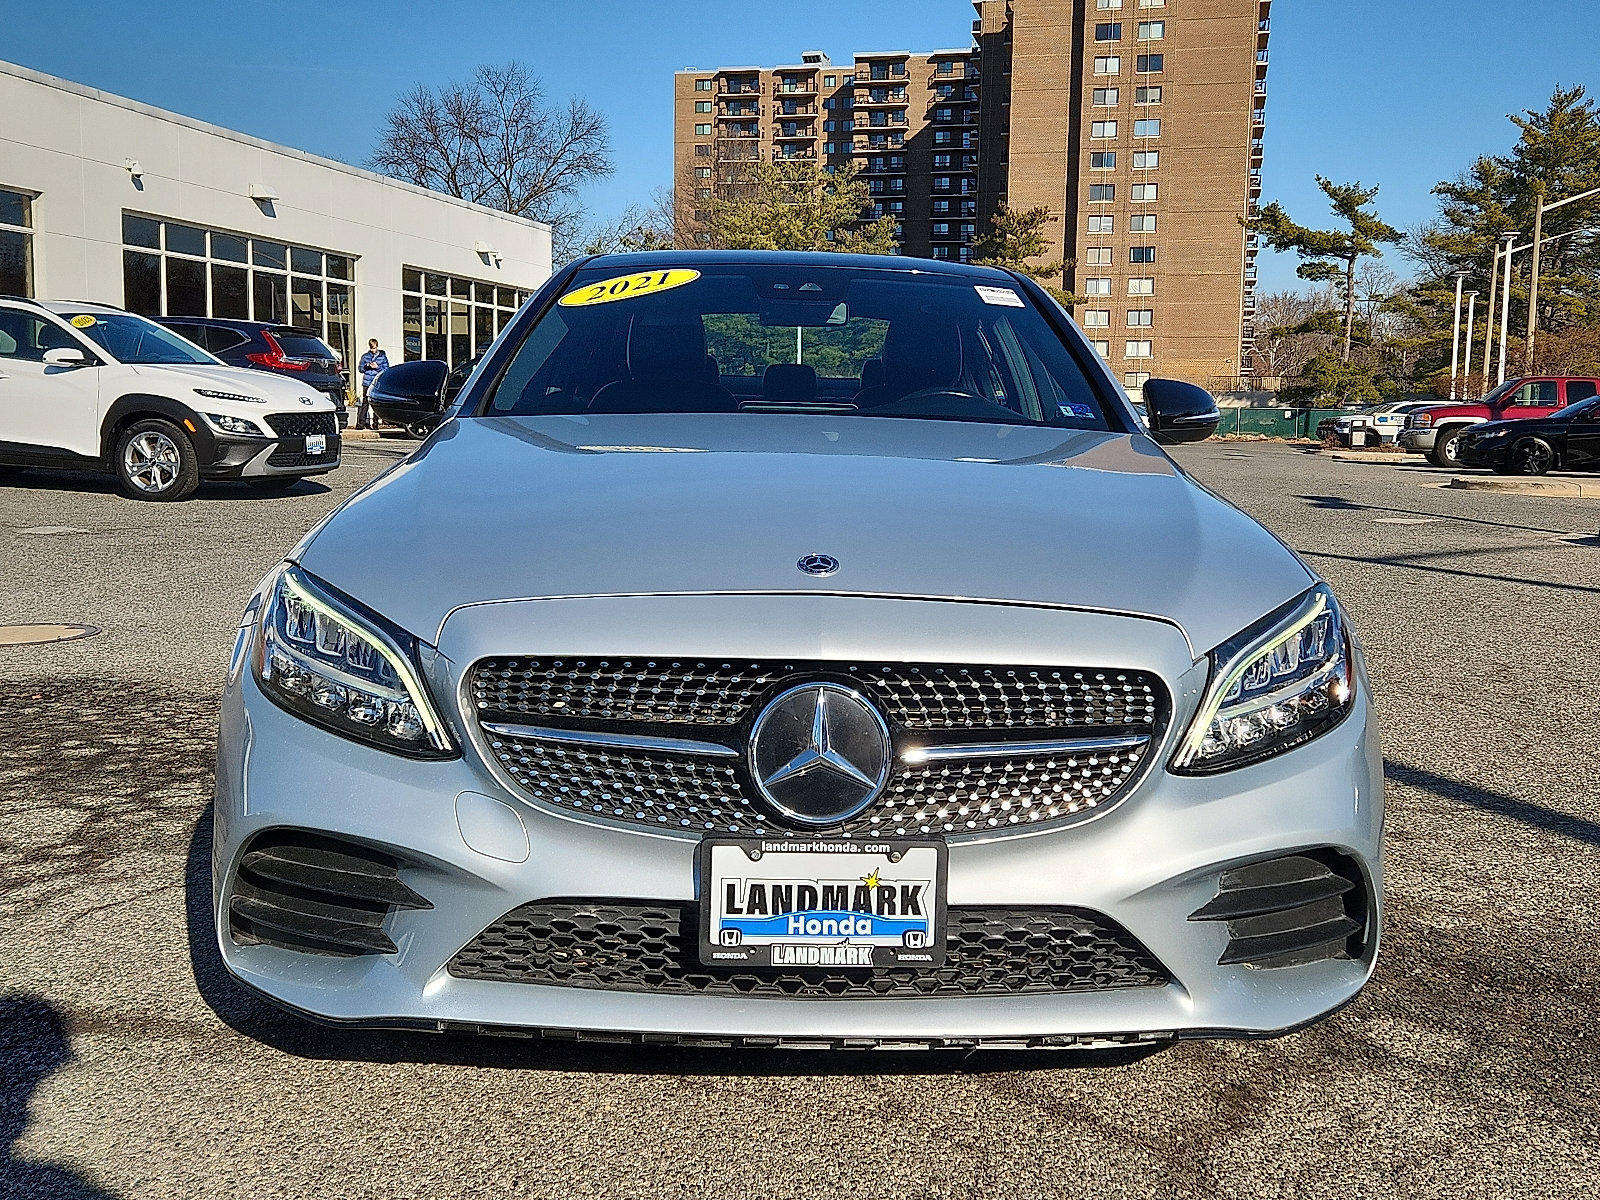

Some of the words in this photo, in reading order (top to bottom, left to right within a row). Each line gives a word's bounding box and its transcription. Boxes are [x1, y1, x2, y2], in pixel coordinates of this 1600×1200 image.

[586, 272, 670, 301] 2021
[725, 883, 923, 916] LANDMARK
[787, 915, 872, 936] Honda
[712, 952, 748, 960] HONDA
[773, 945, 873, 965] LANDMARK
[897, 954, 933, 962] HONDA
